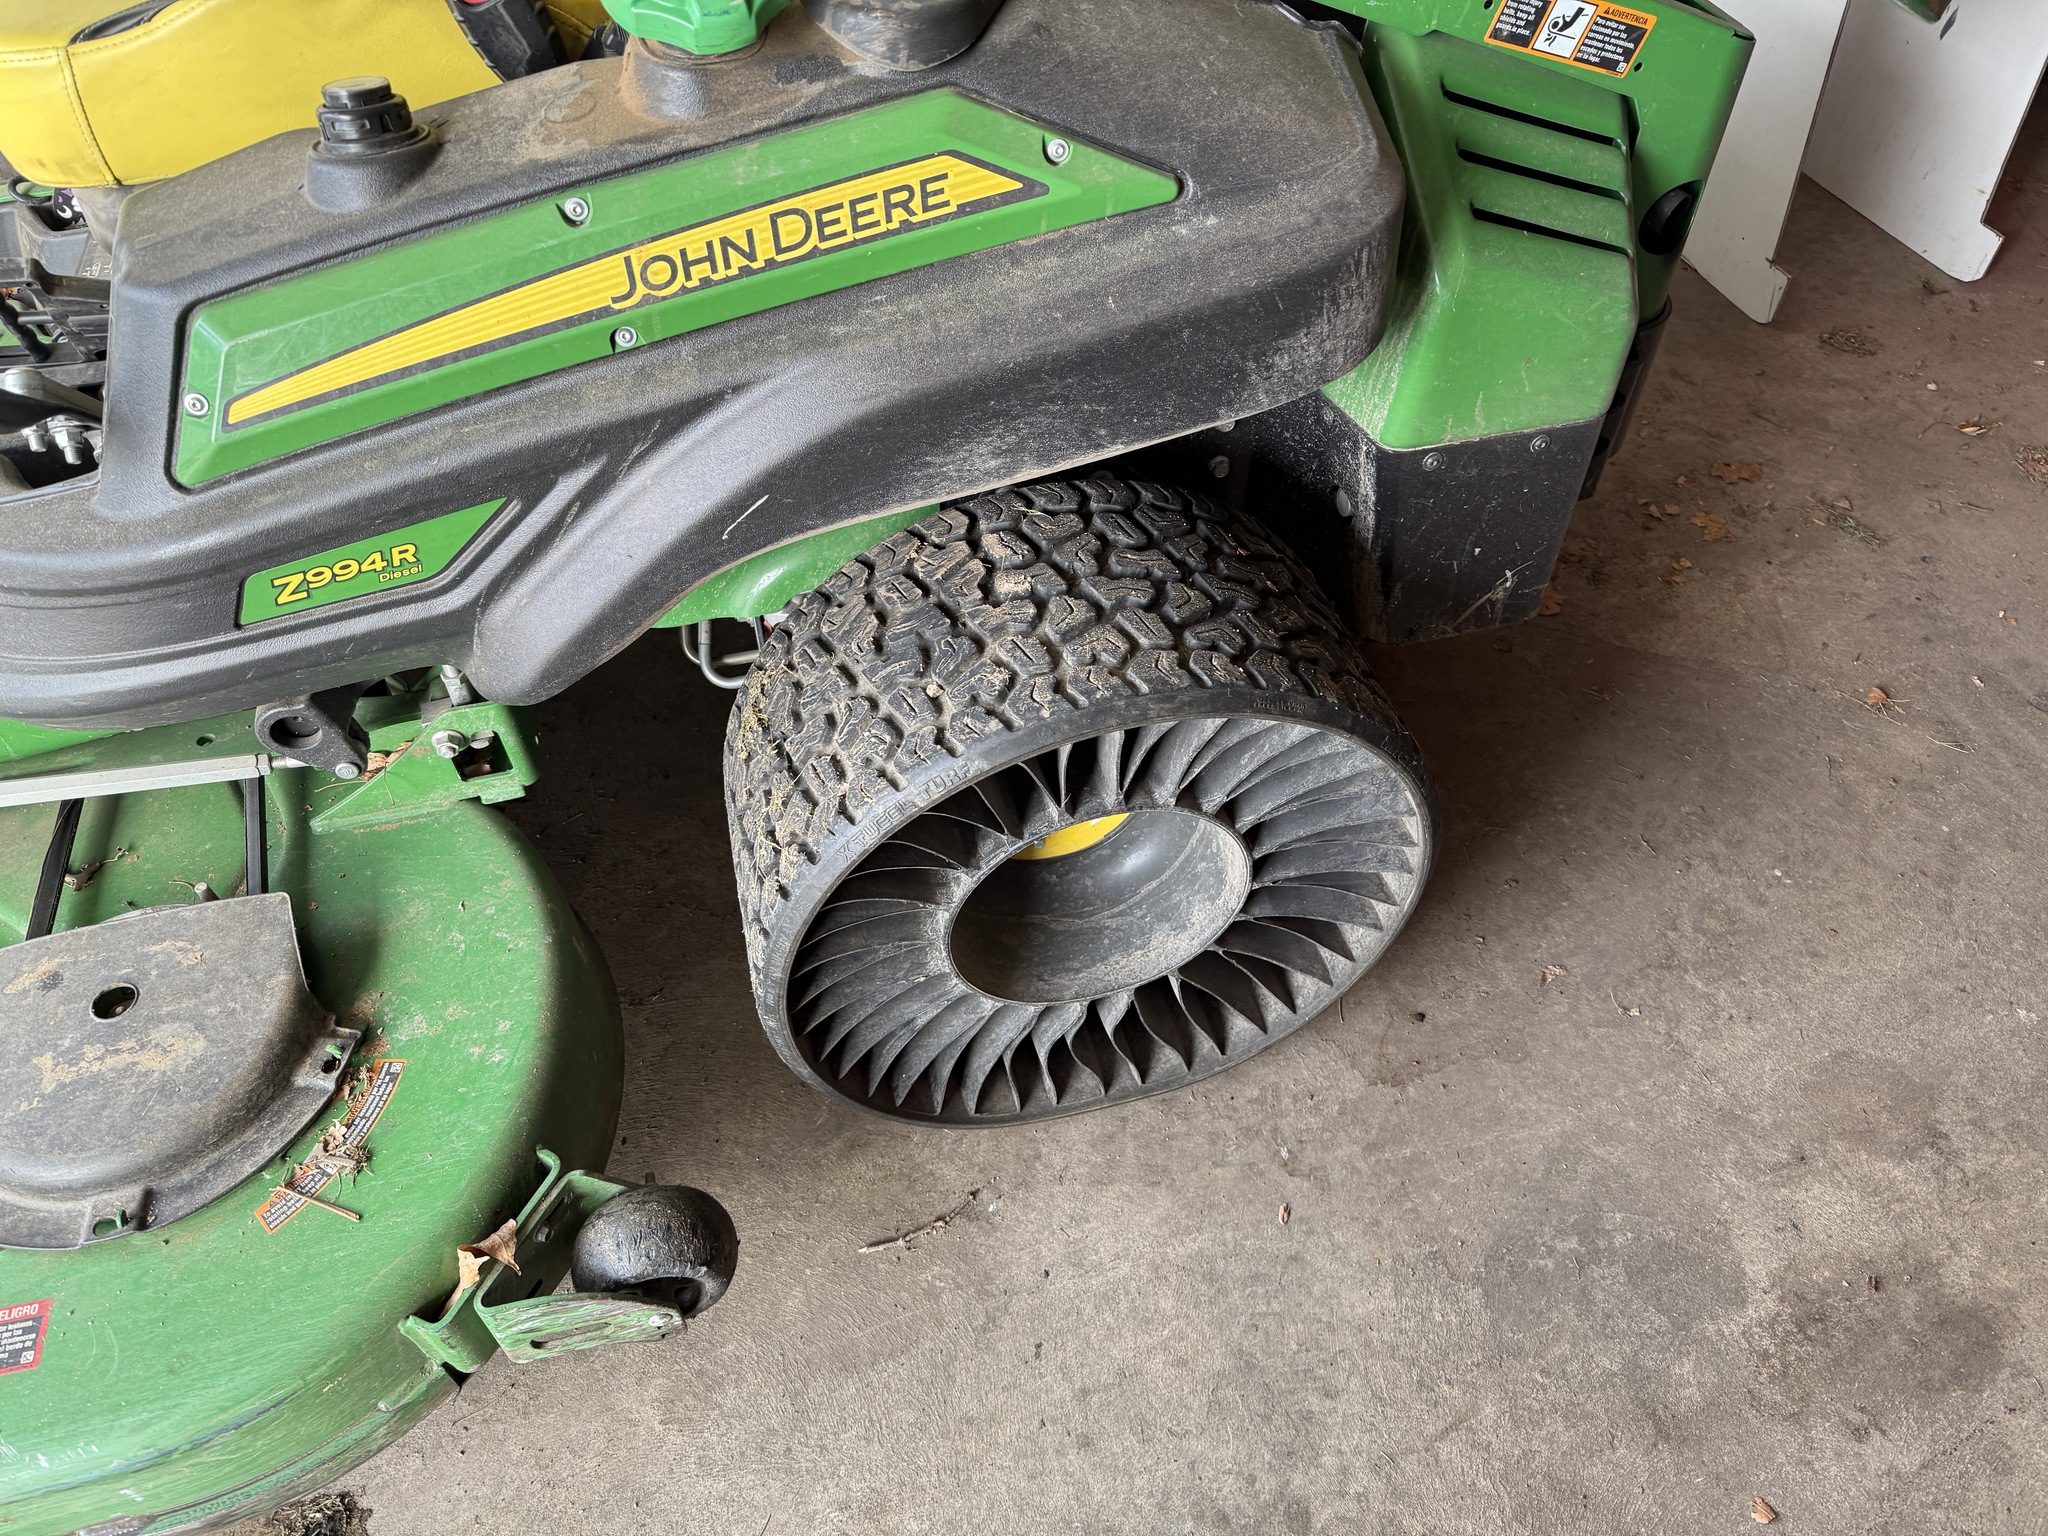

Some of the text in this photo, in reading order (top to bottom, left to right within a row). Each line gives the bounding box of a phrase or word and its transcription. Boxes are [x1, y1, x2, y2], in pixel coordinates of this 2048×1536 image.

[1517, 3, 1536, 14] rotating
[1594, 16, 1627, 31] Para evitar ser
[1609, 8, 1649, 26] ADVERTENCIA
[1587, 31, 1604, 41] correas
[1591, 24, 1628, 39] lesionado por las
[1583, 38, 1625, 54] mantener todos los
[1600, 50, 1625, 62] protectores
[610, 172, 954, 303] JOHN DEERE
[379, 563, 423, 583] Diesel
[852, 800, 917, 848] TWEEL
[916, 761, 974, 801] TURF
[262, 1208, 272, 1219] To
[270, 1198, 287, 1213] avoid
[299, 1175, 314, 1188] from
[265, 1205, 289, 1225] rotating
[269, 1213, 288, 1229] shields
[287, 1206, 297, 1217] and
[0, 1303, 39, 1320] ELIGRO
[2, 1331, 13, 1339] por
[24, 1340, 33, 1348] de
